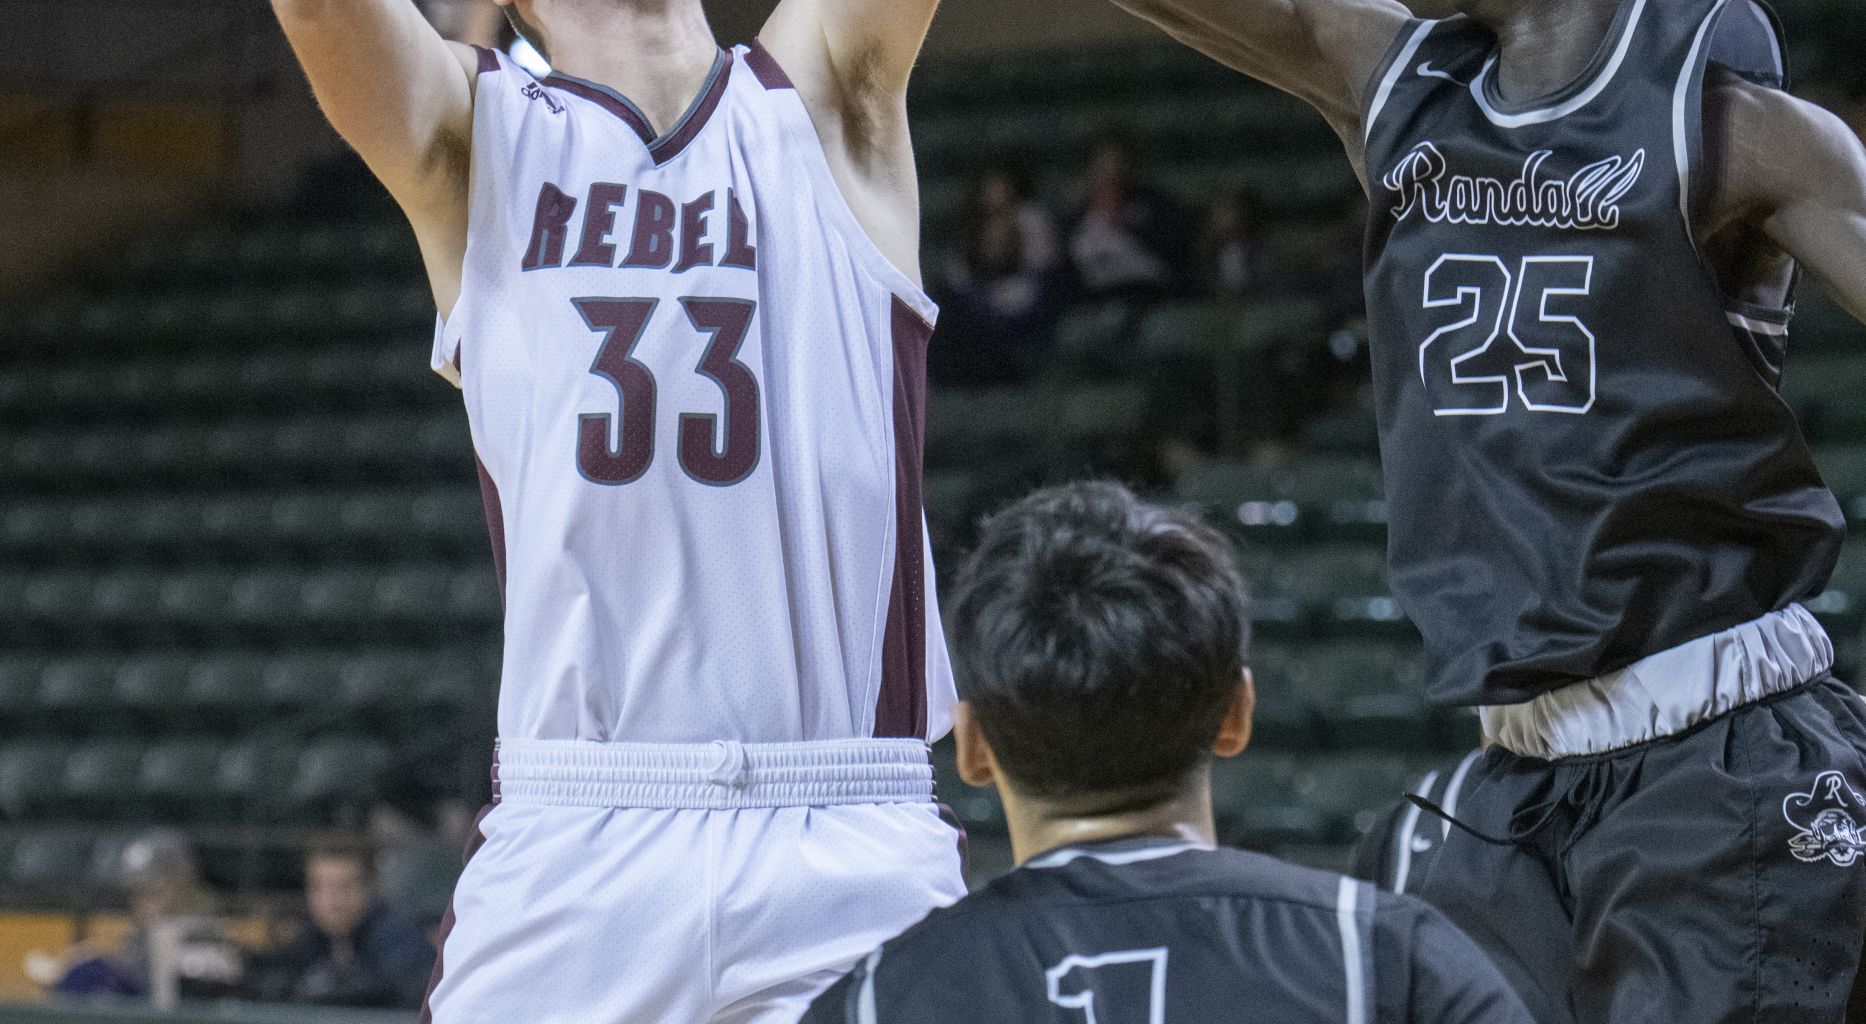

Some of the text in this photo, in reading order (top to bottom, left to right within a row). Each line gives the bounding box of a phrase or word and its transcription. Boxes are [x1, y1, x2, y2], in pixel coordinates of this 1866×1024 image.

[1383, 141, 1646, 230] Randall
[570, 296, 762, 487] 33
[1418, 253, 1597, 416] 25
[1824, 775, 1848, 807] R
